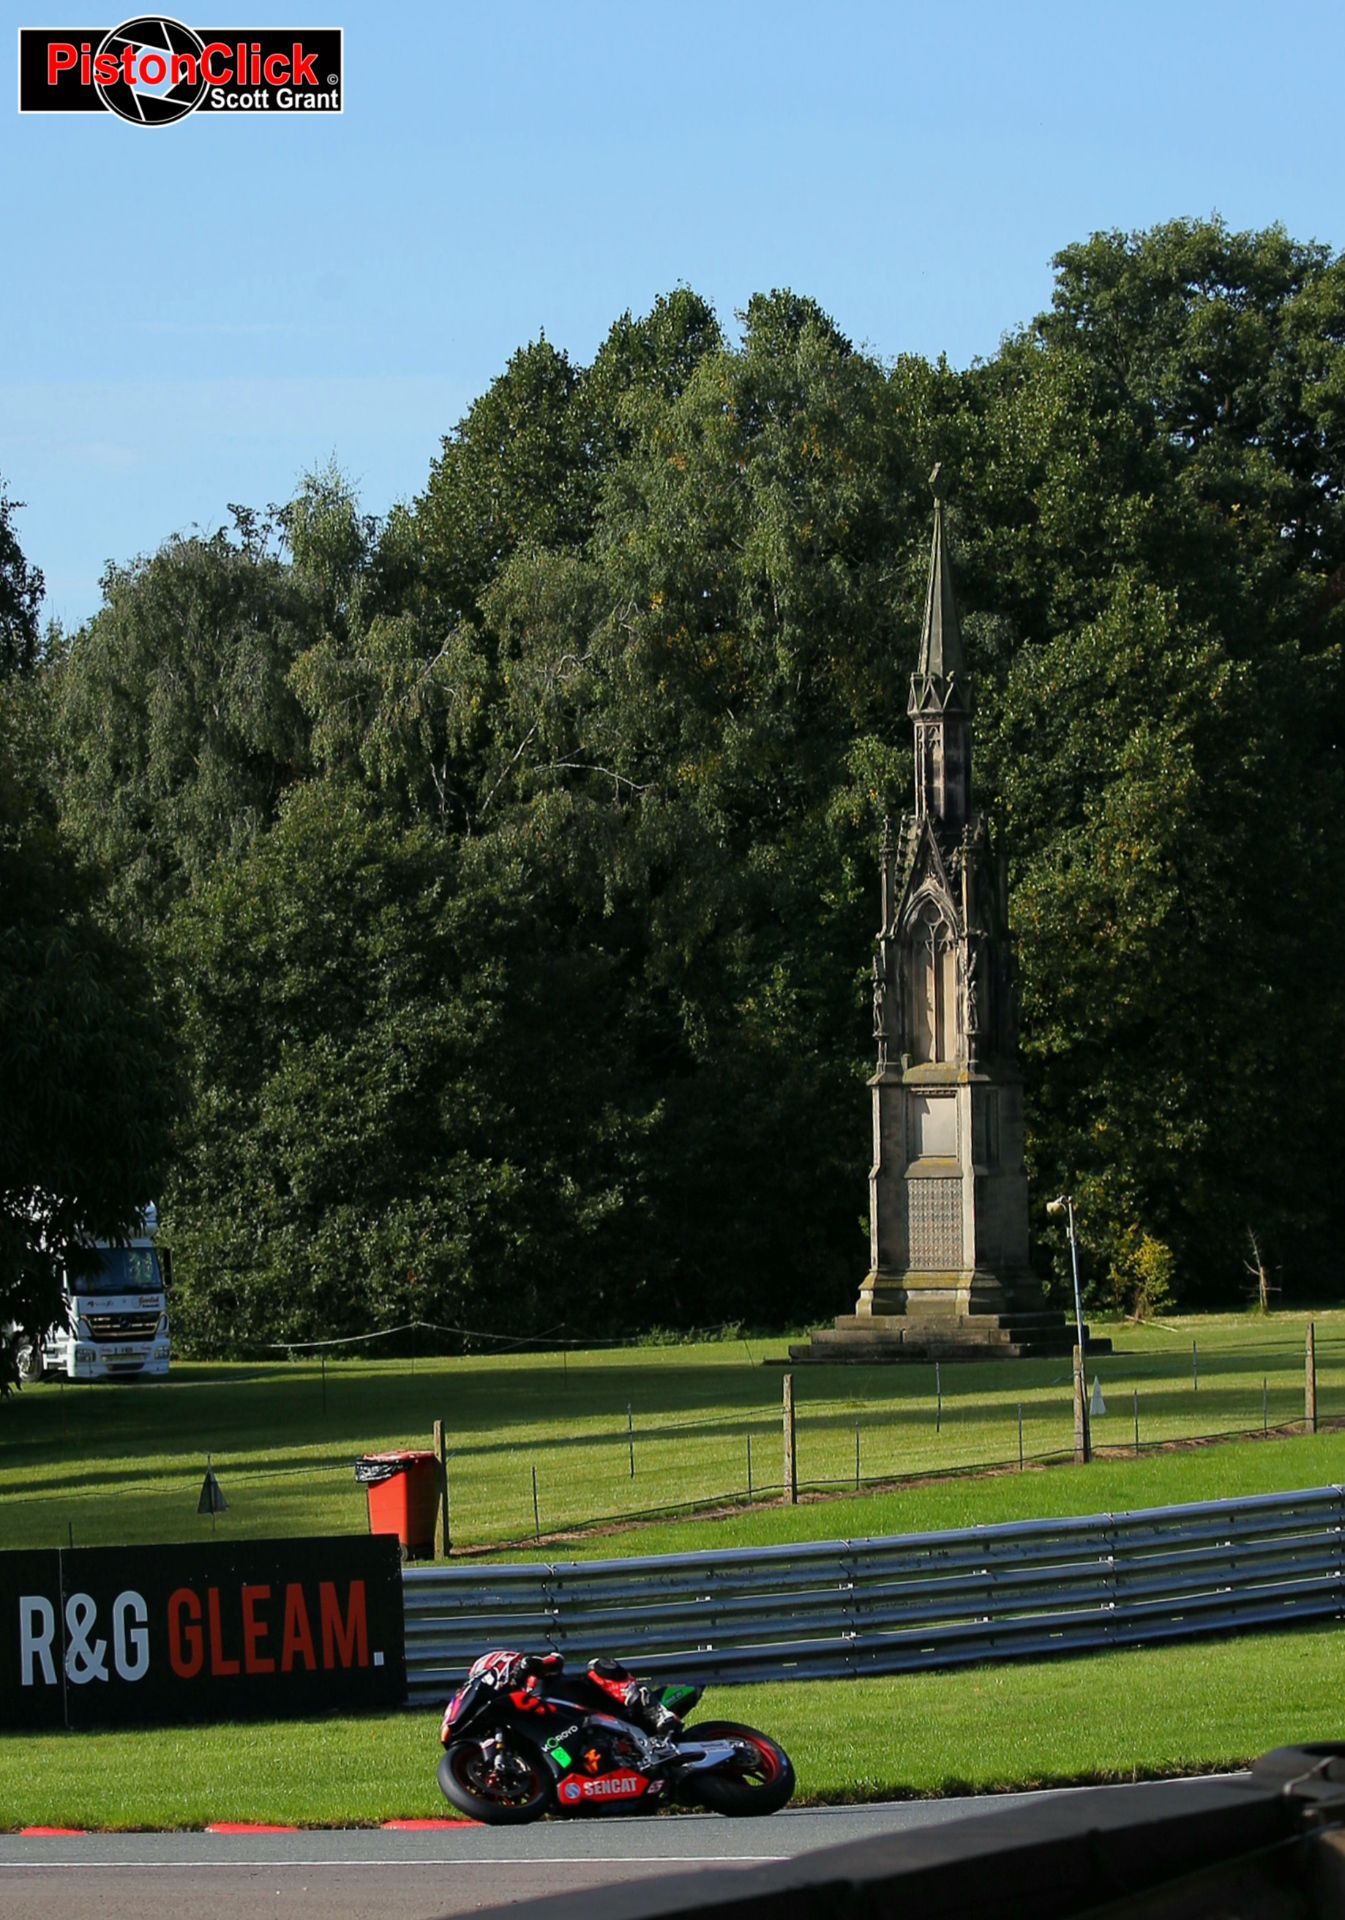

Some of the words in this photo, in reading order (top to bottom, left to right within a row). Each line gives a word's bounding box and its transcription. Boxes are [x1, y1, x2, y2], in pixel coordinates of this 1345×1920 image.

[19, 1590, 151, 1686] R&G
[167, 1580, 385, 1679] GLEAM.
[540, 1725, 579, 1752] KOROYD
[583, 1777, 638, 1796] SENCAT
